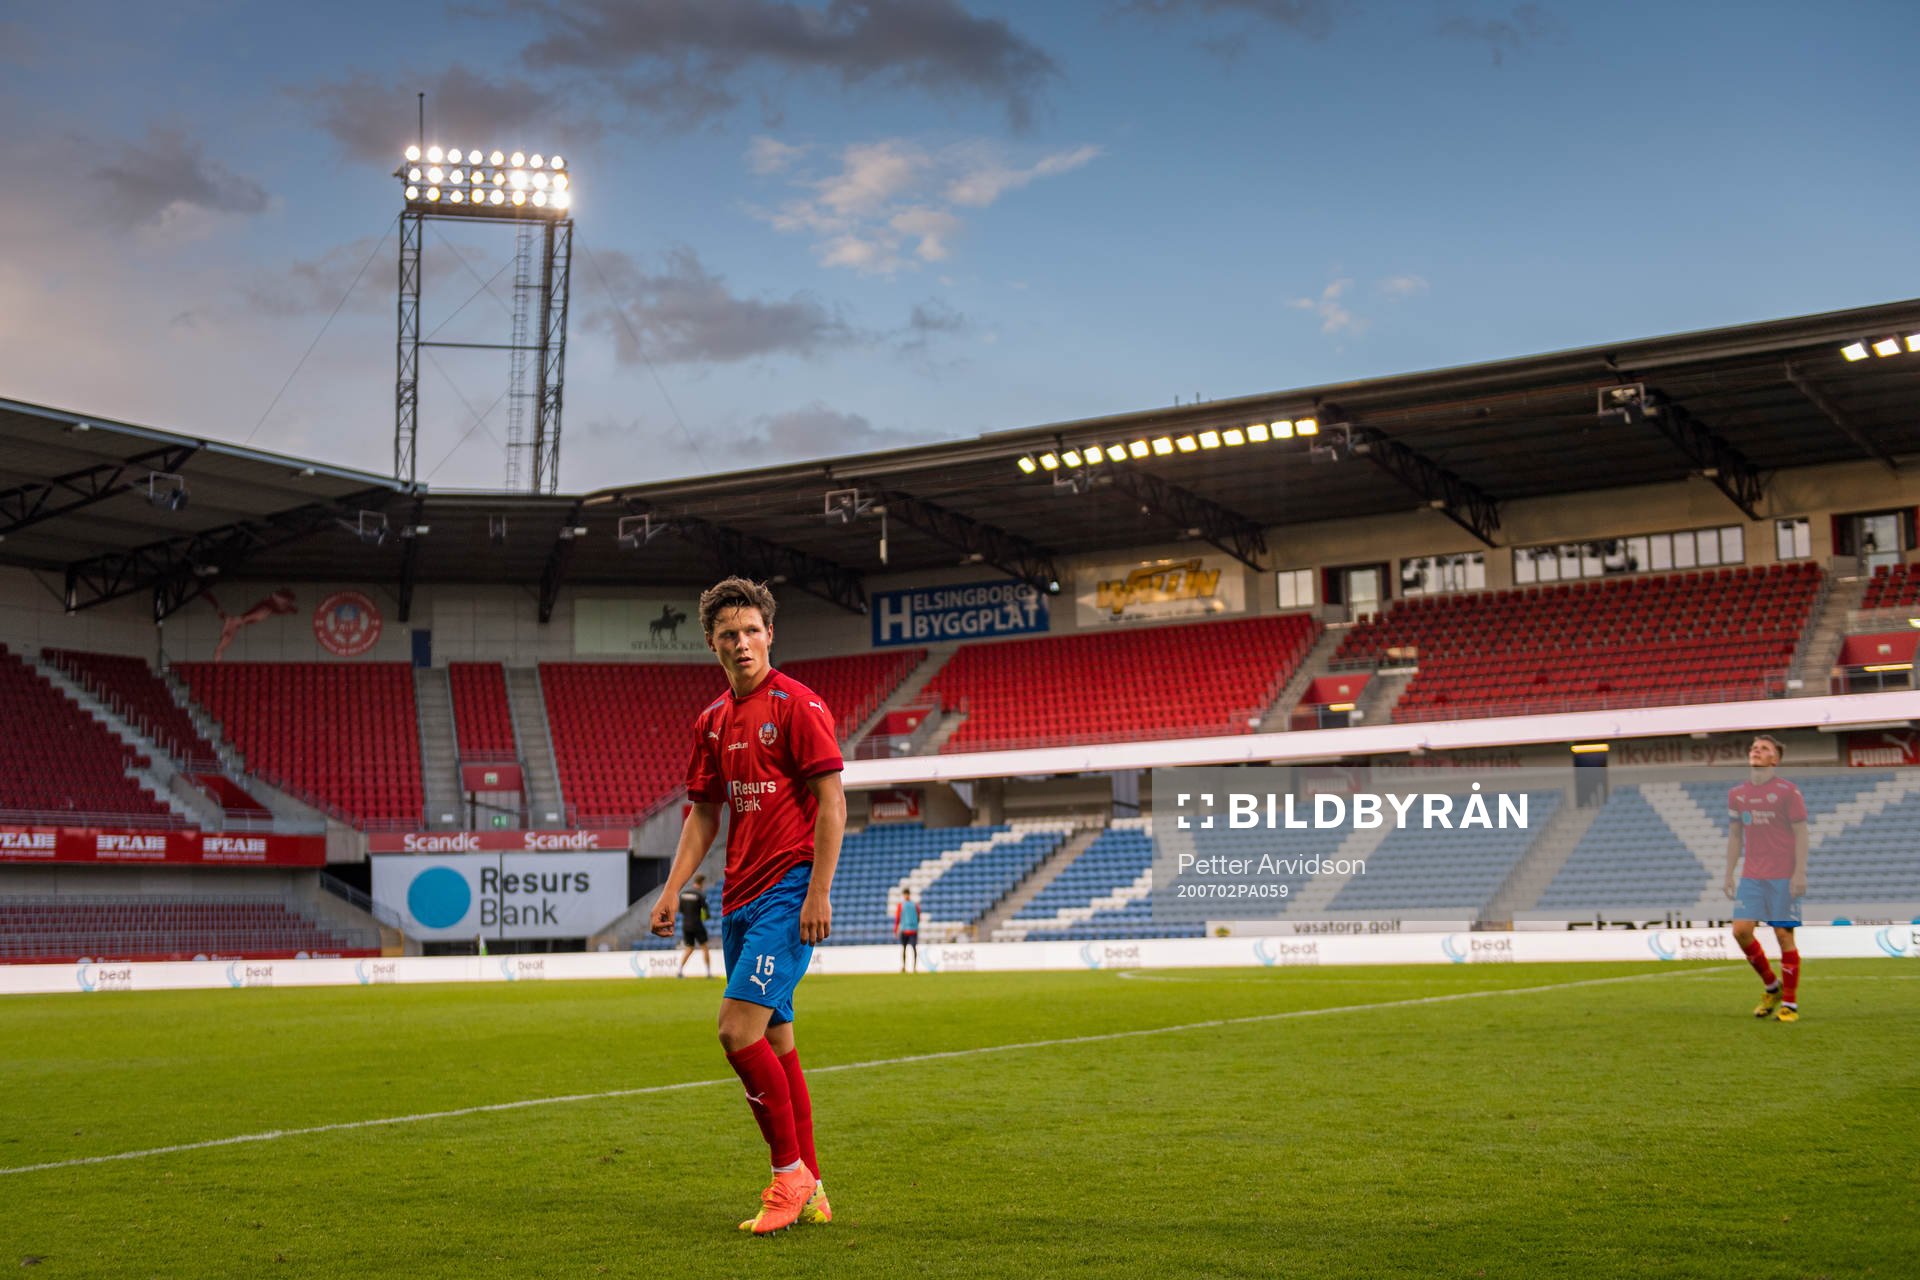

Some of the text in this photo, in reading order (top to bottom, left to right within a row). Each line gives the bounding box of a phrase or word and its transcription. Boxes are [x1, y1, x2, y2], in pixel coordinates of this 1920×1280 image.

[732, 780, 776, 796] Resurs
[735, 797, 762, 813] Bank
[404, 833, 480, 851] Scandic
[524, 832, 598, 849] Scandic
[480, 866, 590, 894] Resurs
[480, 899, 558, 926] Bank
[756, 954, 775, 976] 15
